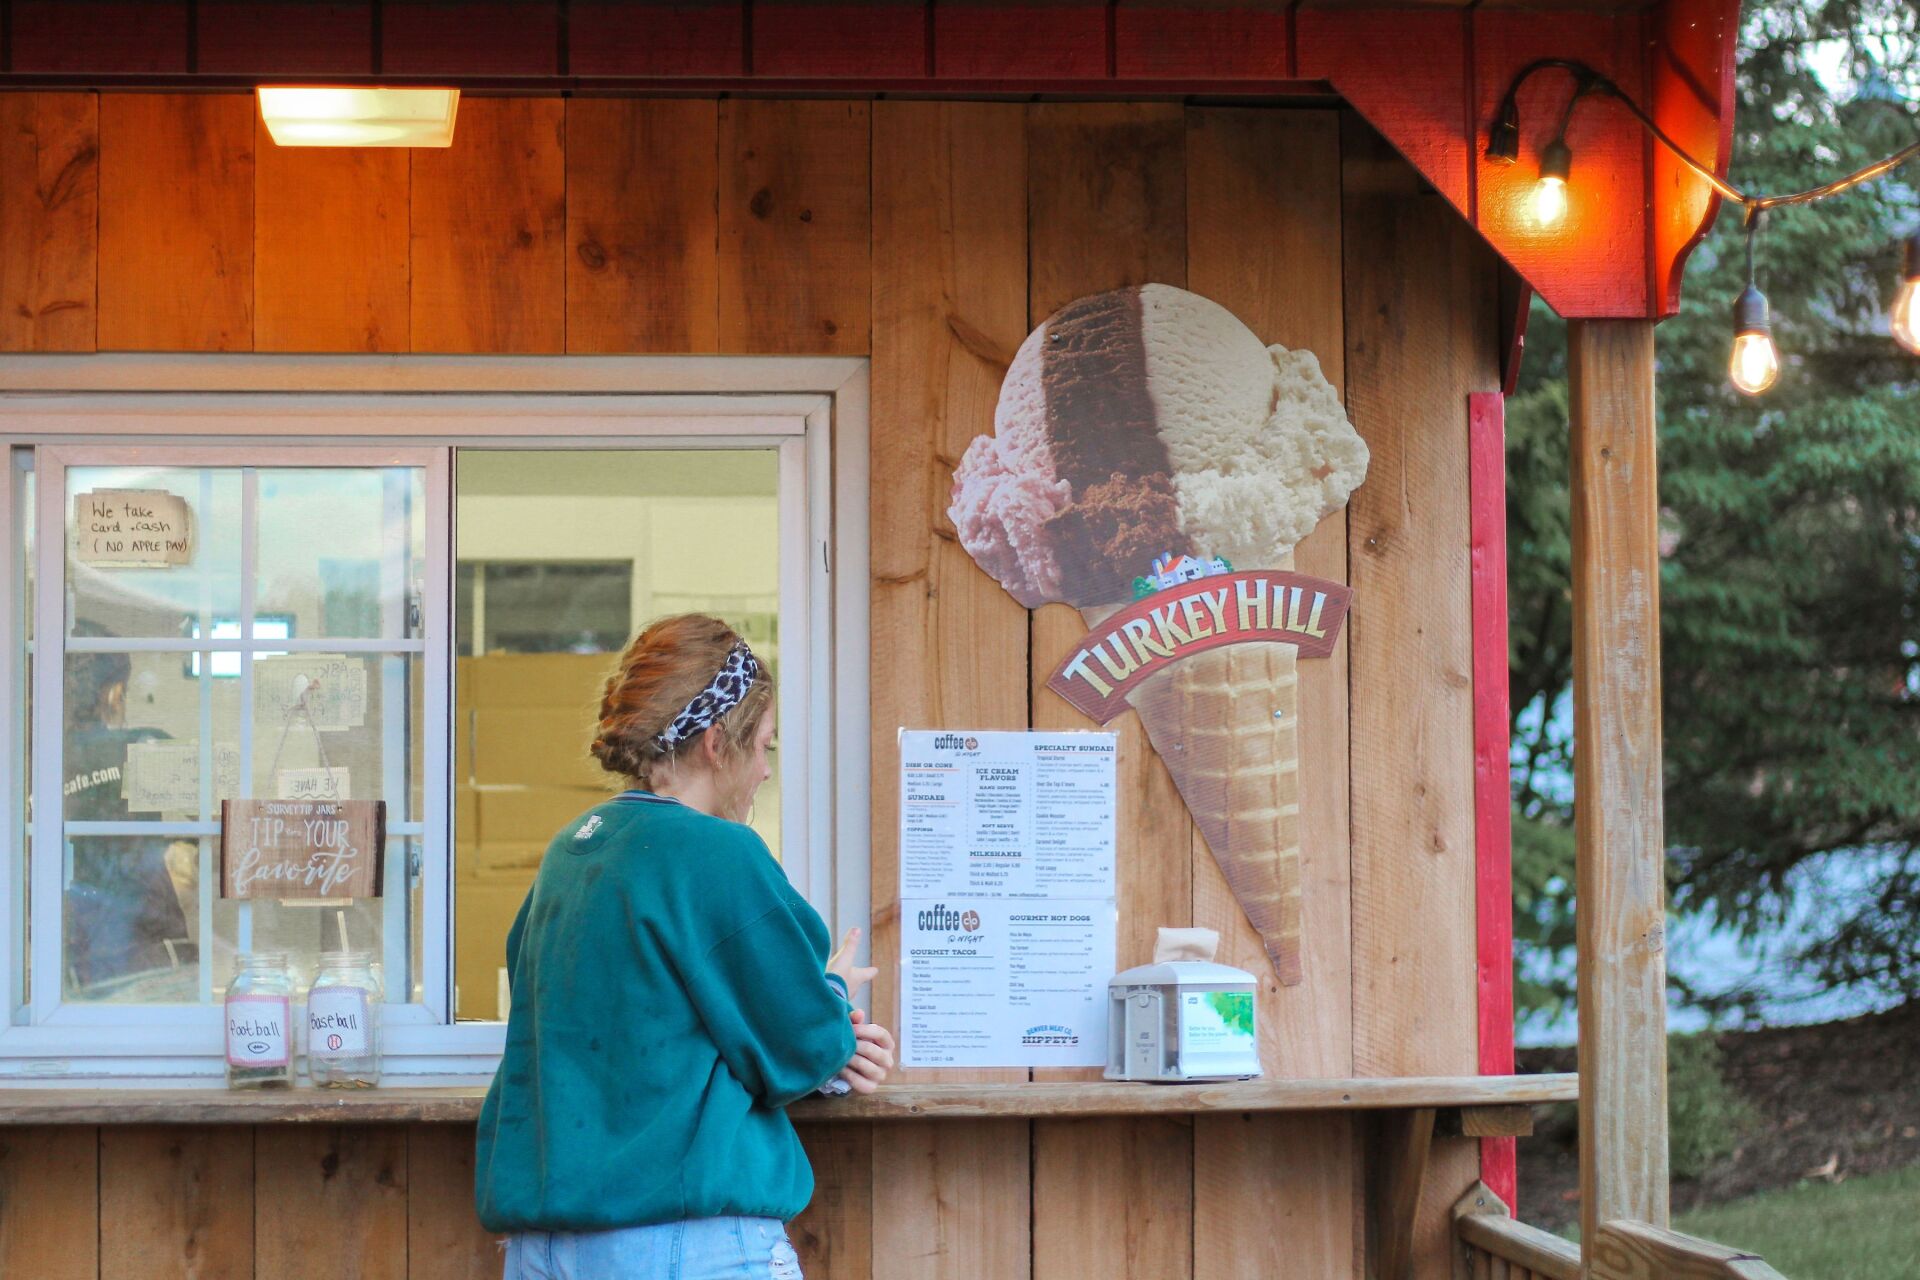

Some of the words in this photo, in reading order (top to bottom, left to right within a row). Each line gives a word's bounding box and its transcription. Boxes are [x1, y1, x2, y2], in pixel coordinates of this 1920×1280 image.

[92, 501, 113, 519] We
[123, 503, 154, 518] take
[132, 542, 161, 552] APPLE
[166, 538, 187, 552] PAY)
[1062, 587, 1228, 698] TURKEY
[1234, 578, 1327, 639] HILL
[934, 734, 964, 750] coffee
[316, 804, 337, 815] JARS
[250, 817, 284, 847] TIP
[303, 818, 350, 848] YOUR
[231, 847, 361, 896] favorite
[918, 904, 960, 931] coffee
[948, 935, 955, 944] @
[957, 935, 984, 944] NIGHT
[1049, 1024, 1064, 1032] MEAT
